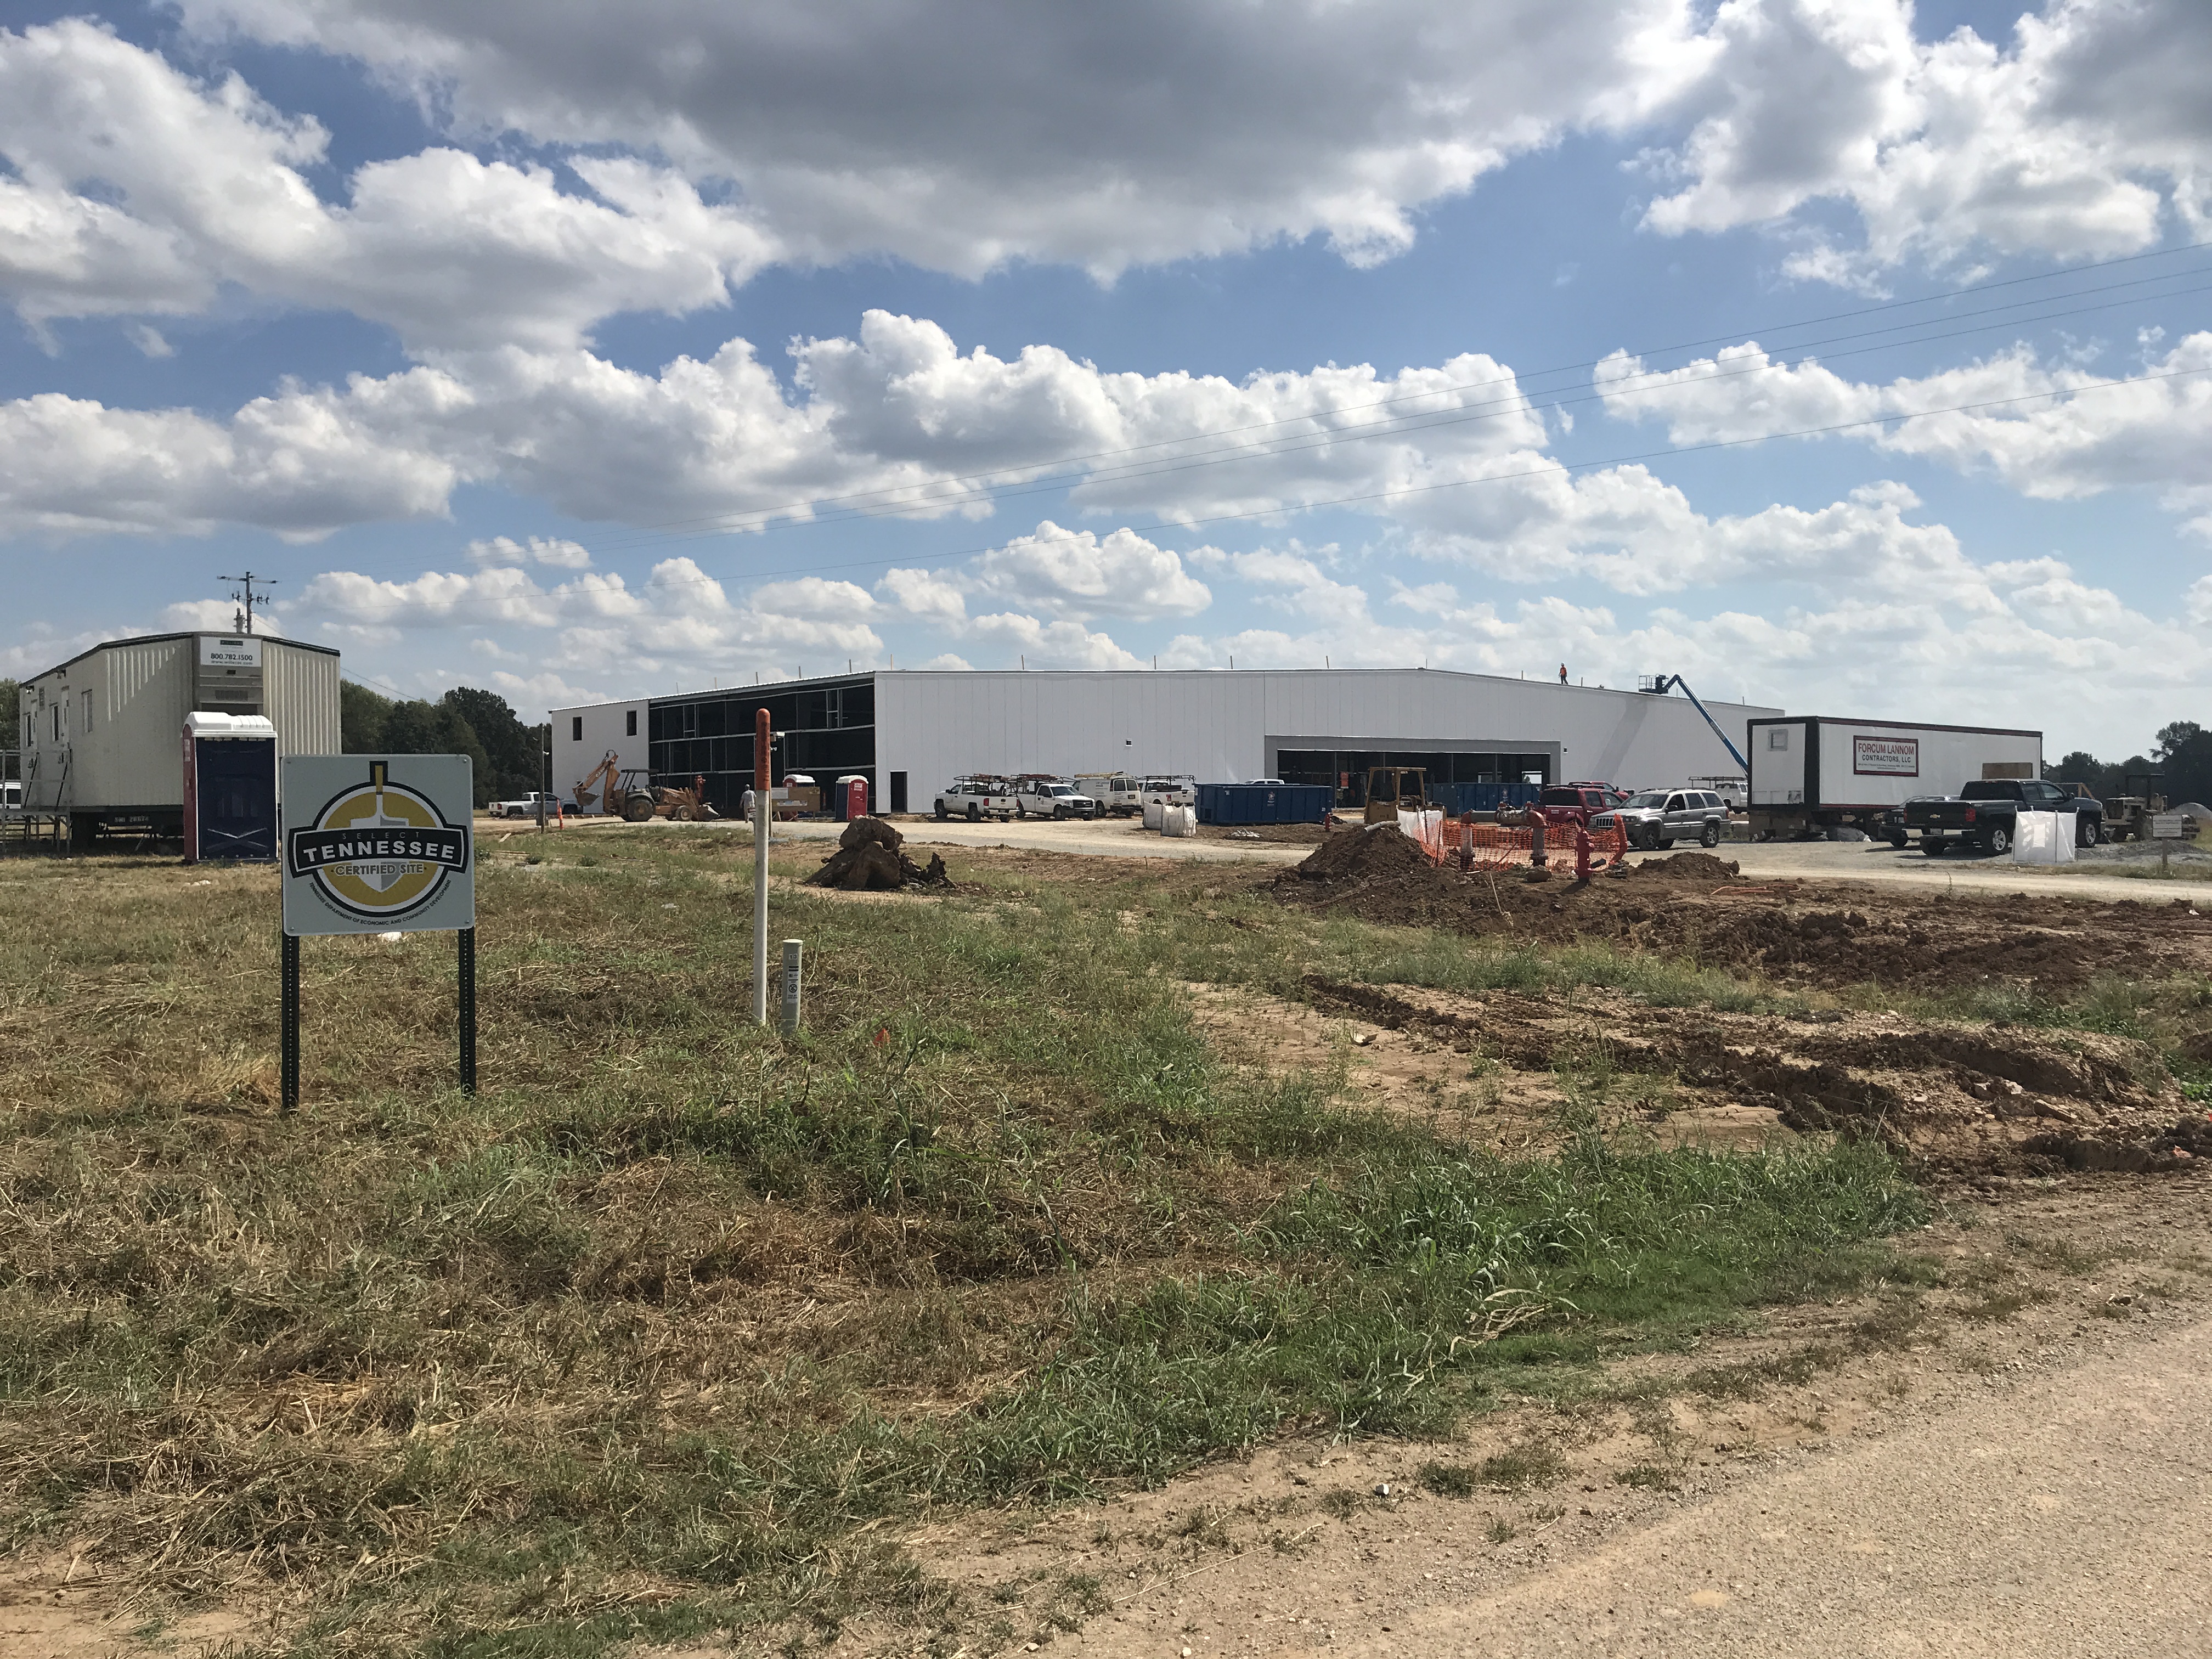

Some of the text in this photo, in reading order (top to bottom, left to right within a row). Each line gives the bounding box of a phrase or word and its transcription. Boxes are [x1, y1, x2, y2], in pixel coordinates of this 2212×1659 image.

[1858, 743, 1914, 755] FORCUM LANNOM
[1862, 754, 1900, 763] CONTRACTORS,
[303, 841, 455, 862] TENNESSEE
[335, 864, 424, 876] CERTIFIED SITE
[309, 882, 326, 904] TENNESSEE
[325, 901, 353, 921] DEPARTMENT
[402, 906, 431, 922] COMMUNITY
[430, 879, 452, 907] DEVELOPMENT
